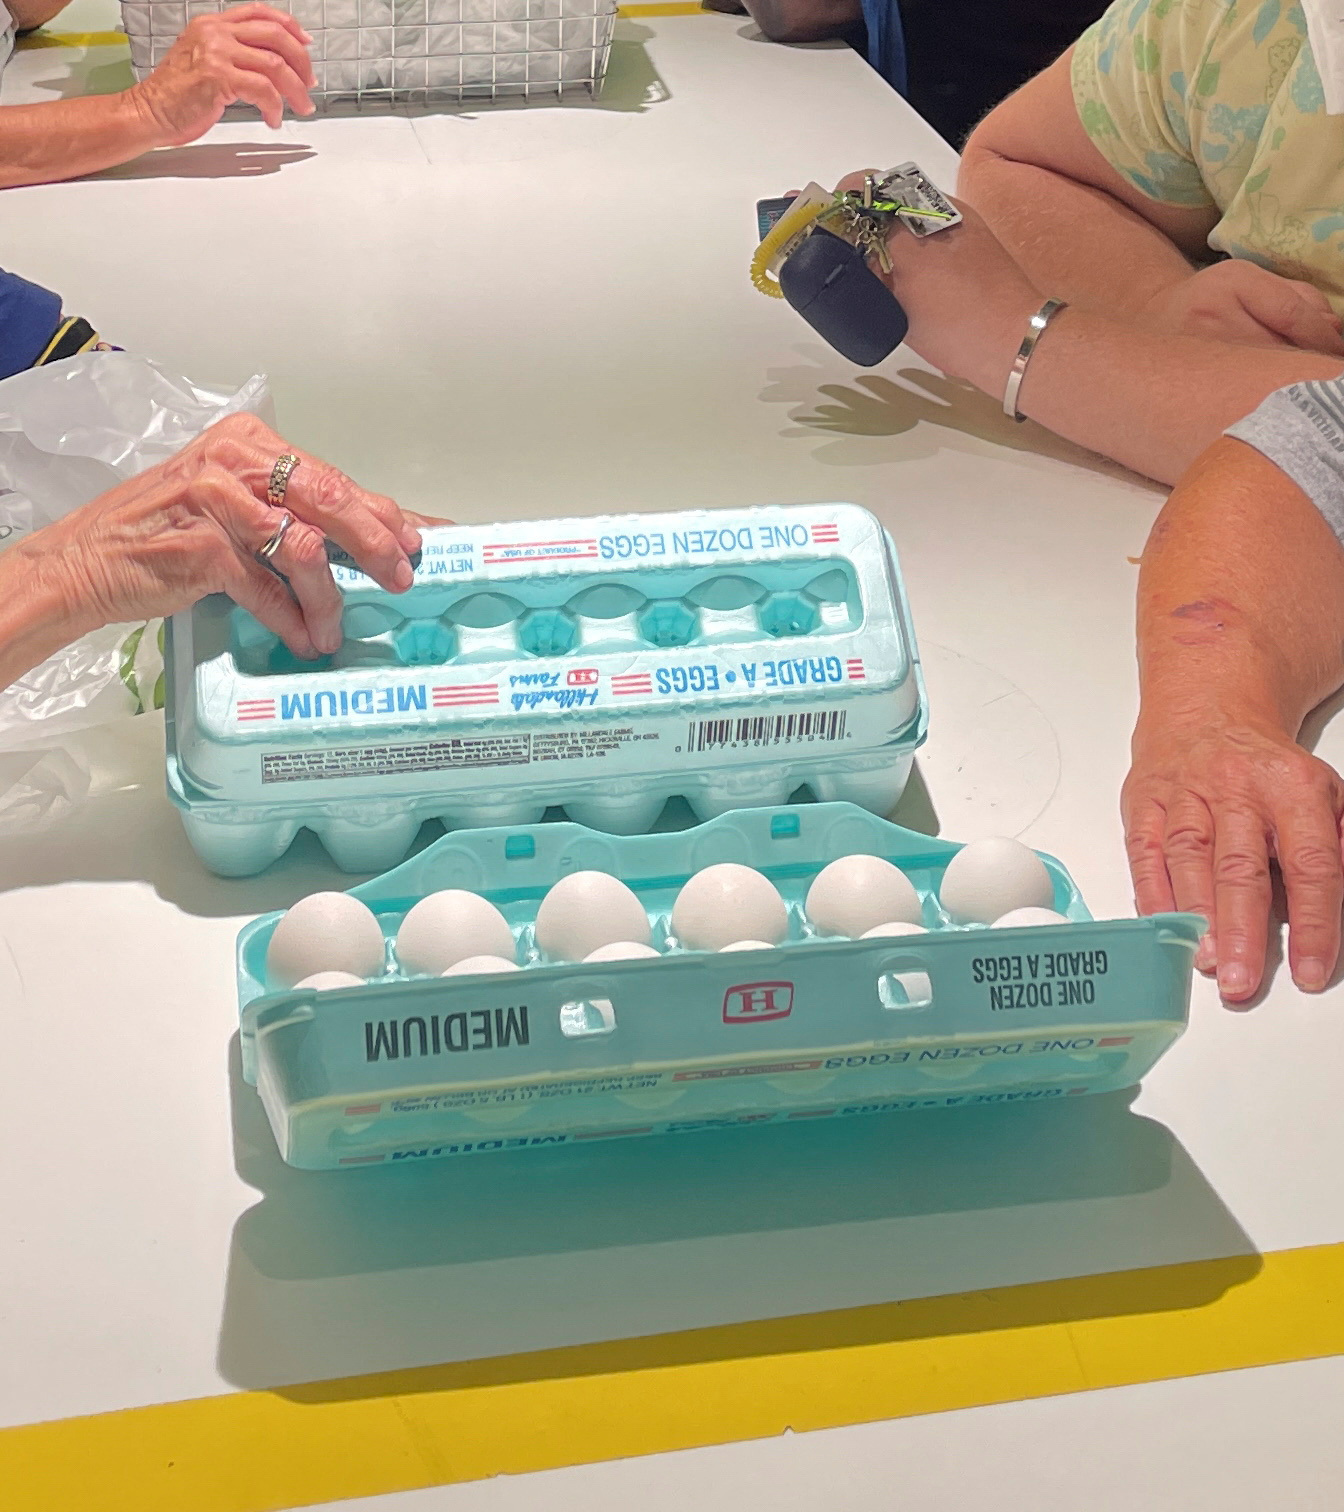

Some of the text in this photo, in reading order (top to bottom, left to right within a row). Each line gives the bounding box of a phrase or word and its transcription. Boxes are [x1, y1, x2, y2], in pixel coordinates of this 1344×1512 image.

[446, 543, 474, 554] KEEP
[599, 523, 809, 559] ONE DOZEN EGGS
[449, 558, 474, 573] NET
[510, 672, 560, 688] Farms
[657, 656, 843, 693] GRADE A EGGS
[281, 684, 428, 720] MEDIUM
[972, 950, 1108, 983] GRADE A EGGS
[739, 988, 779, 1013] H
[991, 979, 1096, 1011] ONE DOZEN
[365, 1005, 530, 1062] MEDIUM
[824, 1037, 1095, 1070] ONE DOZEN EGGS
[392, 1134, 567, 1160] MEDIUM
